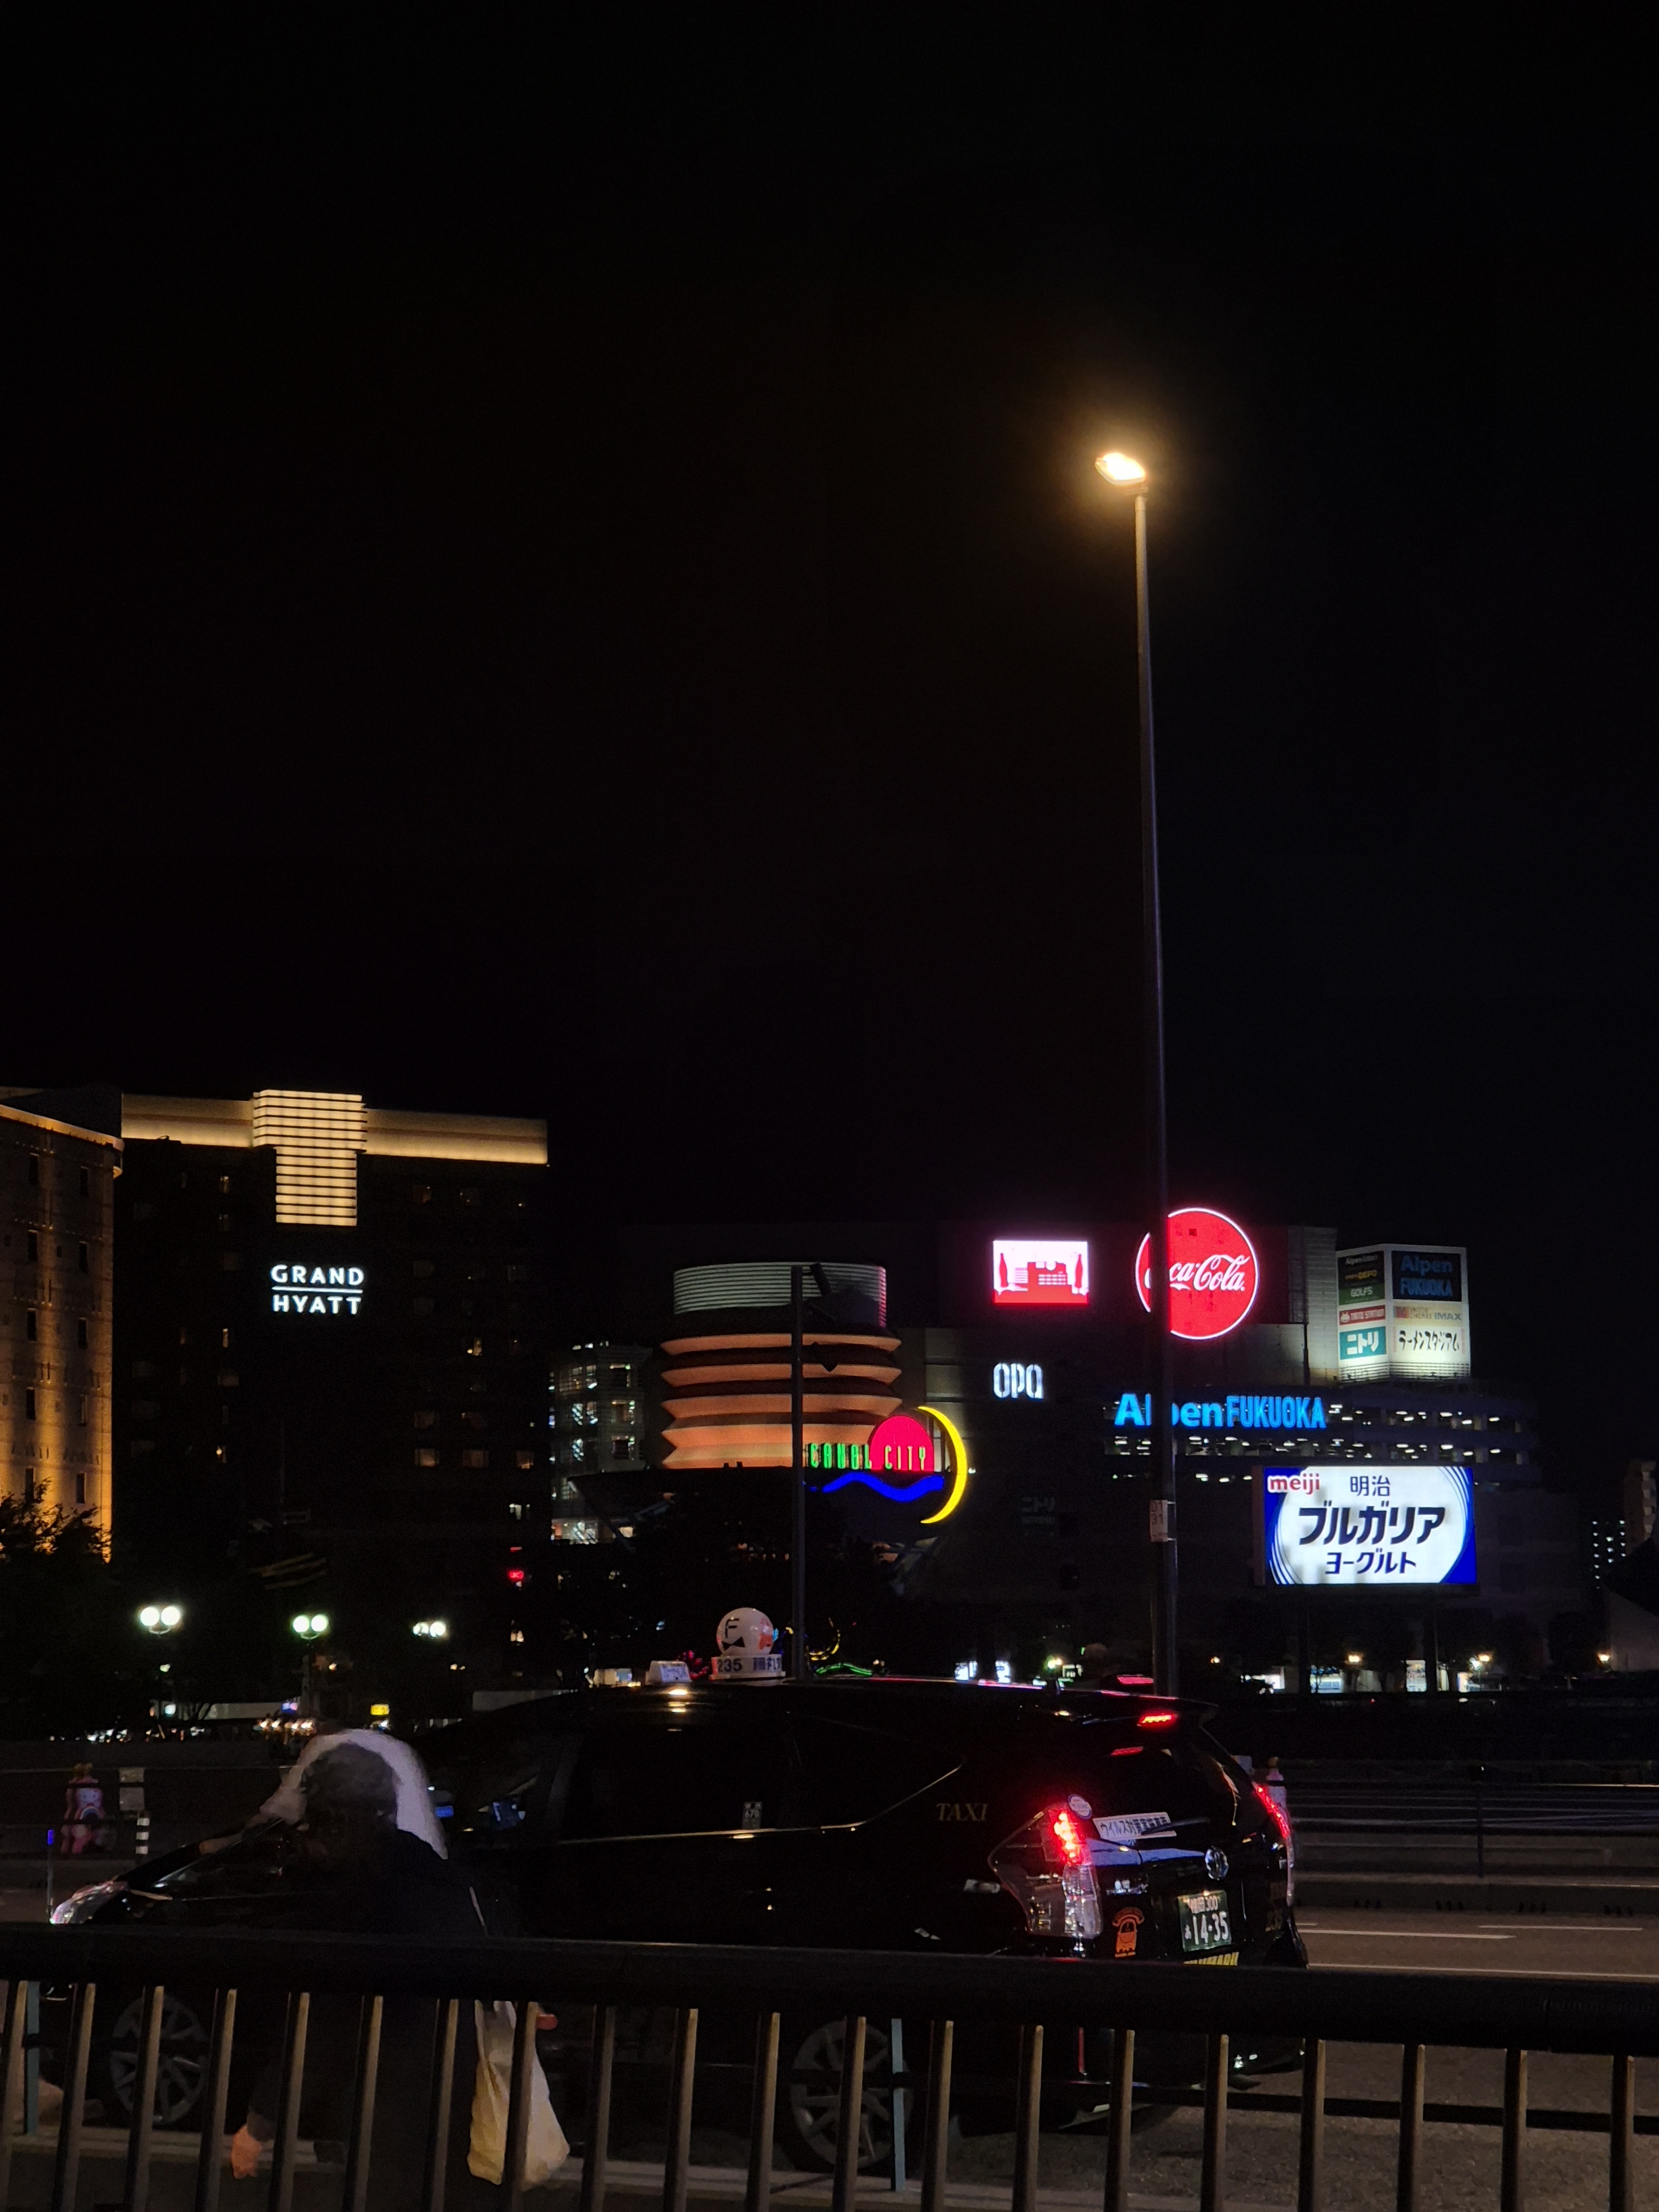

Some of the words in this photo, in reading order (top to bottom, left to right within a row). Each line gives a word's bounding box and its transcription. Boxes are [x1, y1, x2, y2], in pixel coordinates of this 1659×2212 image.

[270, 1264, 364, 1286] GRAND
[1144, 1255, 1250, 1291] ca-Cola
[1400, 1254, 1453, 1277] Alpen
[1400, 1277, 1453, 1296] FUKUOKA
[272, 1294, 362, 1314] HYATT
[1434, 1312, 1462, 1321] IMAX
[1347, 1331, 1379, 1355] ニトリ
[1399, 1330, 1459, 1351] ラーメンスタジアム
[1227, 1395, 1327, 1428] FUKUOKA
[811, 1443, 872, 1469] CANAL
[885, 1444, 926, 1470] CITY
[1270, 1473, 1320, 1494] meiji
[1350, 1475, 1390, 1496] 明治
[1298, 1500, 1445, 1545] ブルガリア
[1325, 1548, 1416, 1574] ヨーグルト
[936, 1803, 987, 1822] TAXI
[1205, 1895, 1218, 1911] 300
